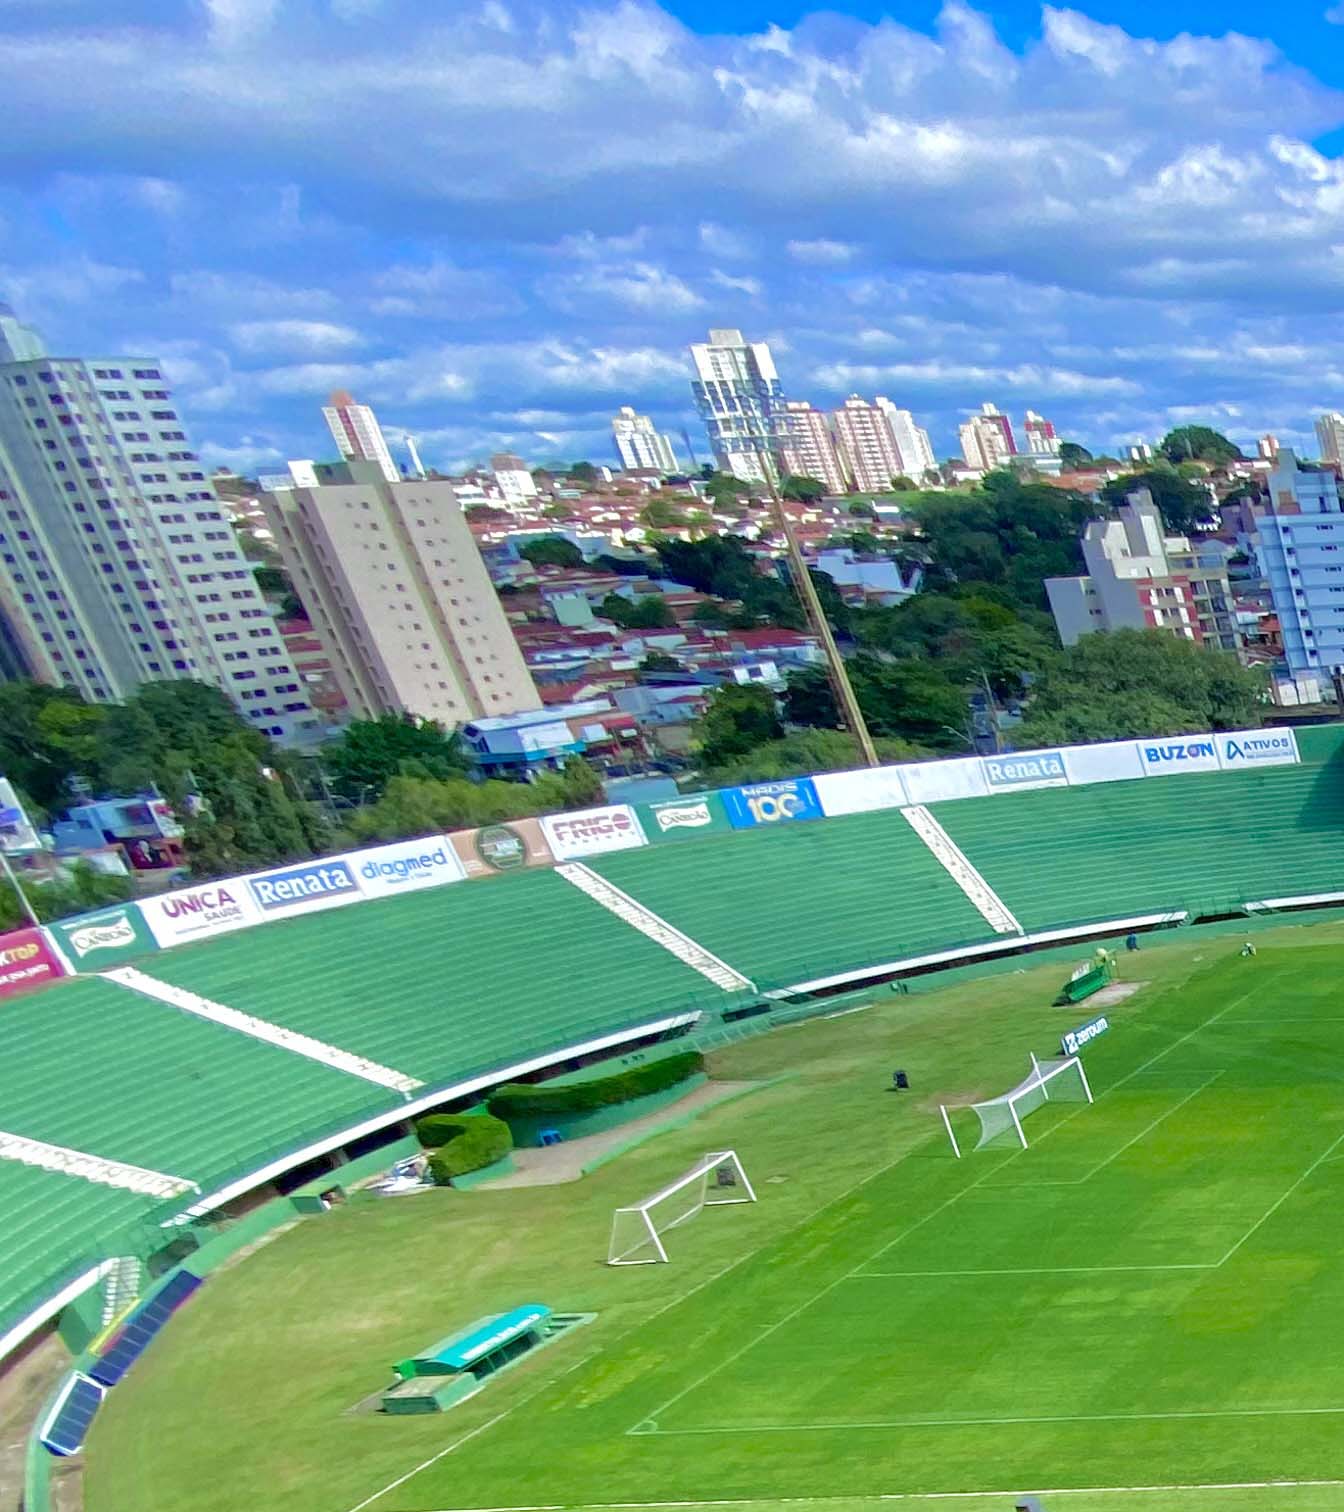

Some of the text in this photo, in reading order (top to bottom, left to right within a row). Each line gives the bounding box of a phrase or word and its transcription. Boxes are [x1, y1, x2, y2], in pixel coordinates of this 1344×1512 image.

[1146, 743, 1214, 762] BUZON
[1243, 738, 1290, 751] ATIVOS
[988, 758, 1062, 782] Renata
[552, 813, 631, 842] FRIGO
[361, 848, 448, 879] diagmed
[253, 866, 352, 903] Renata
[1076, 1018, 1108, 1045] zeroum
